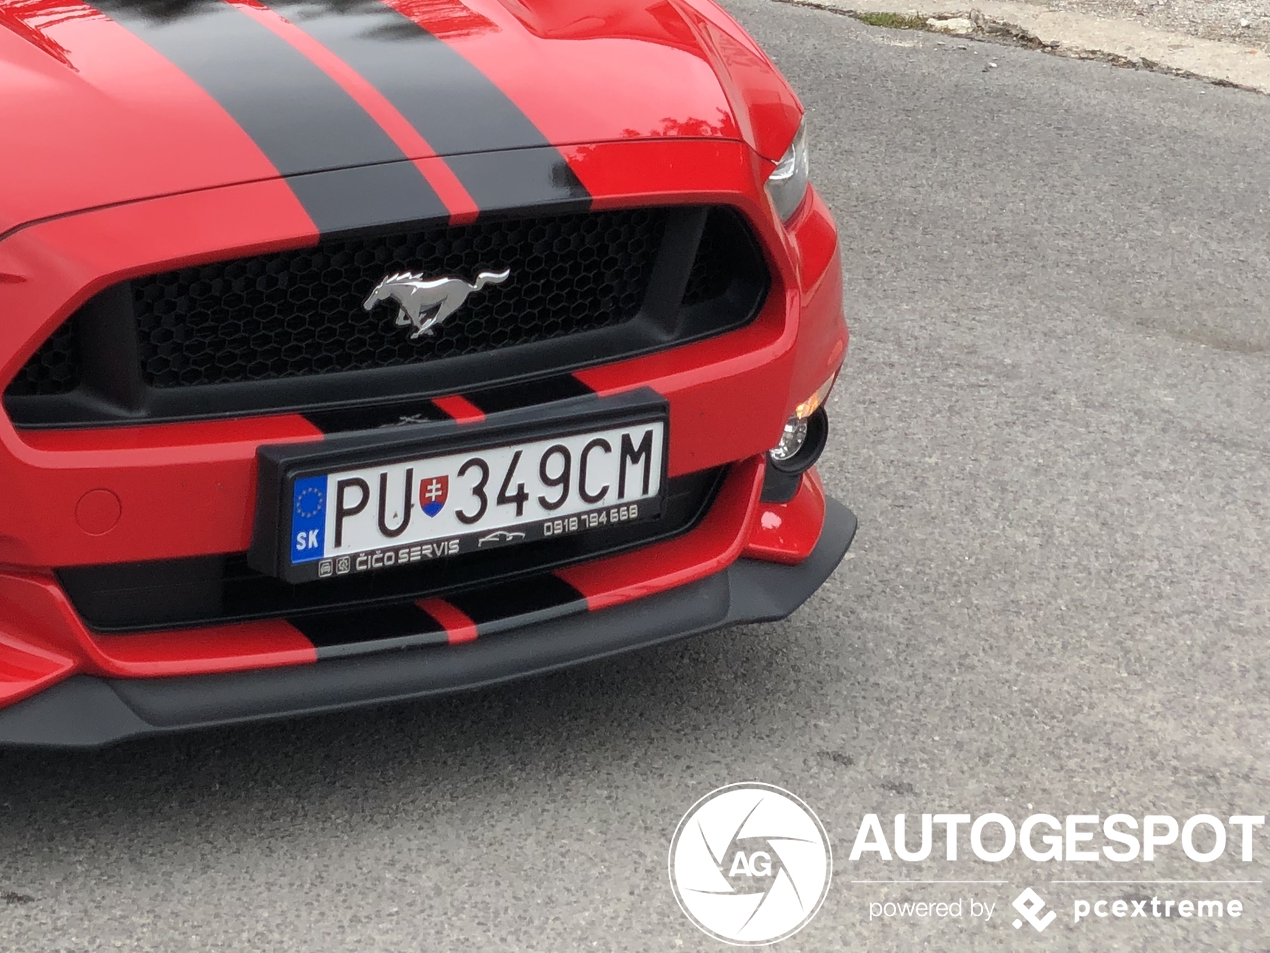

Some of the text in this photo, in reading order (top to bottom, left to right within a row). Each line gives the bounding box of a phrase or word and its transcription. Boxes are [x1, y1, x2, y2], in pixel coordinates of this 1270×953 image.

[334, 429, 654, 548] PU 349CM
[543, 517, 578, 536] 0918
[581, 511, 607, 528] 794
[296, 529, 319, 550] SK
[398, 539, 460, 564] SERVIS
